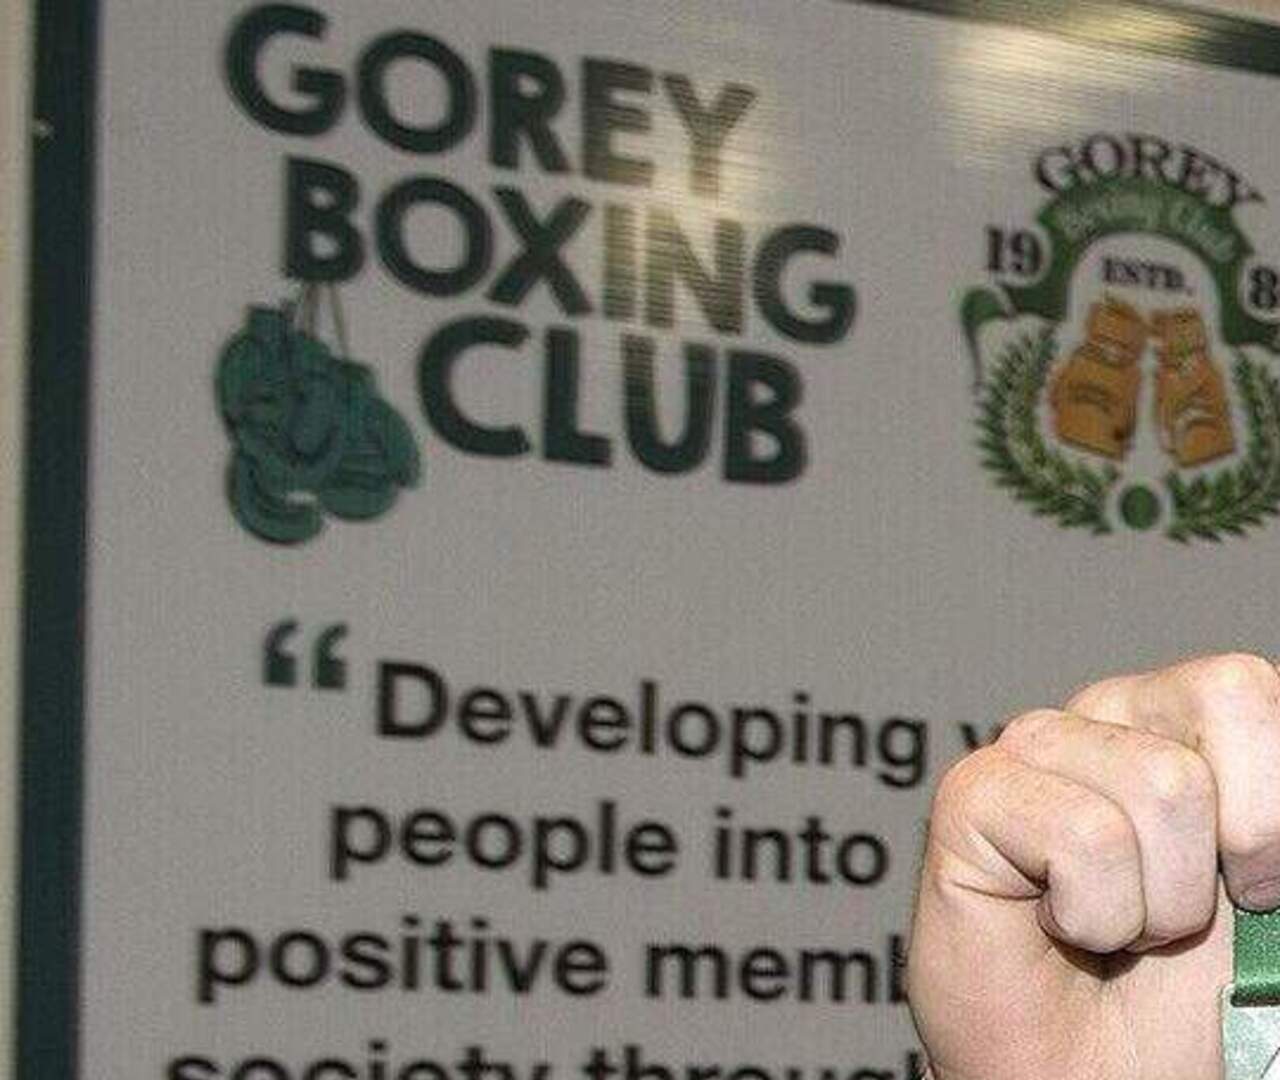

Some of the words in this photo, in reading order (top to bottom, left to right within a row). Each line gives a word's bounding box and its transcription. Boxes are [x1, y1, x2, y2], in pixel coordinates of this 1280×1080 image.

[224, 3, 757, 196] GOREY
[1036, 133, 1266, 206] GOREY
[282, 154, 858, 346] BOXING
[416, 315, 809, 486] CLUB
[374, 658, 927, 789] Developing
[330, 800, 680, 890] people
[713, 806, 891, 887] into
[198, 917, 608, 1002] positive
